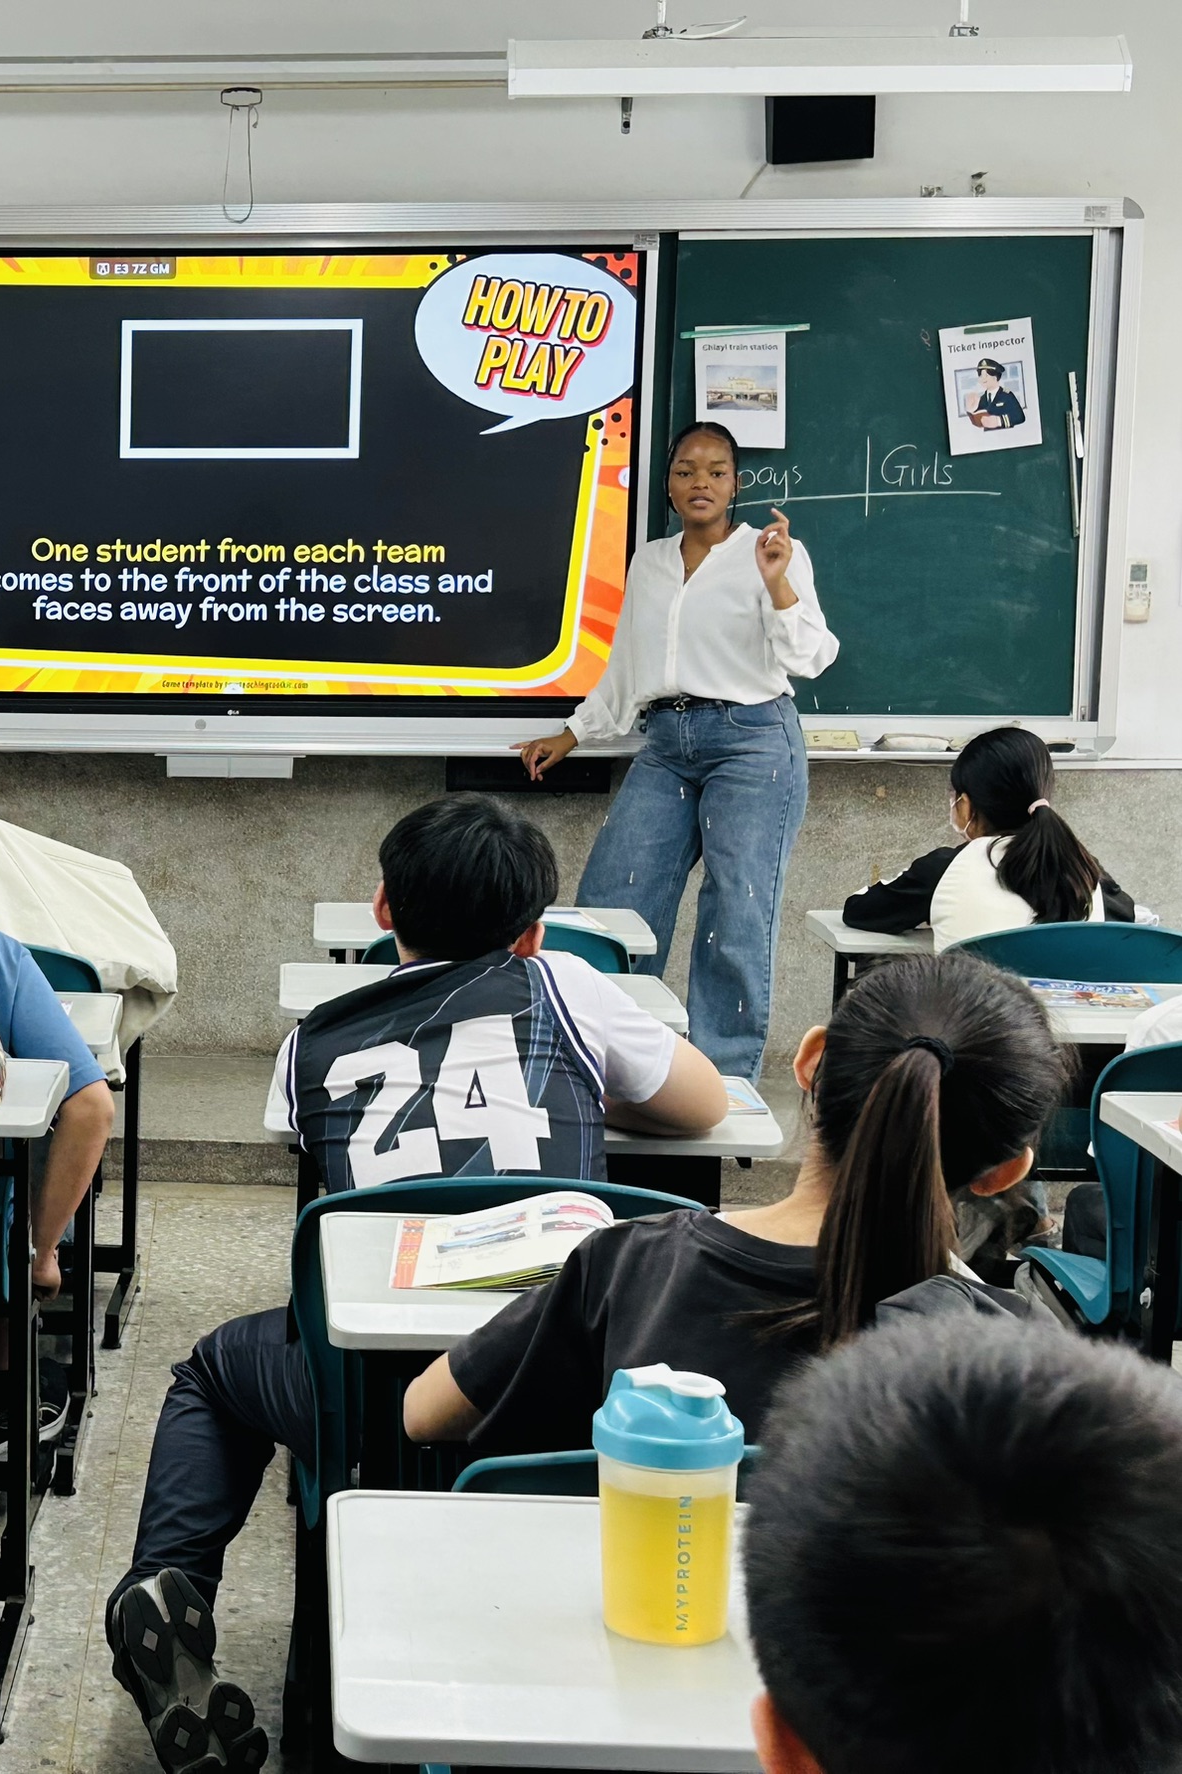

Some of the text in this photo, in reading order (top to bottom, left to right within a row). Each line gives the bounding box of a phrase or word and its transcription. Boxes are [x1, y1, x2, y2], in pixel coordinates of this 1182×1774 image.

[114, 263, 170, 275] E3 7Z GM
[463, 273, 613, 344] HOW TO
[729, 343, 748, 351] train
[750, 343, 778, 351] station
[947, 343, 976, 354] Ticket
[475, 335, 584, 397] PLAY
[881, 443, 953, 487] Girls
[31, 537, 446, 564] One student from each team
[80, 567, 112, 592] to
[118, 567, 168, 592] the
[174, 566, 253, 593] front
[258, 567, 292, 594] of
[295, 567, 347, 594] the
[353, 564, 430, 594] class
[437, 569, 493, 594] and
[32, 595, 442, 629] faces away from the screen.
[162, 680, 181, 689] Game
[182, 680, 214, 690] template
[215, 681, 223, 690] by
[323, 1013, 551, 1188] 24
[676, 1495, 692, 1631] MYPROTEIN
